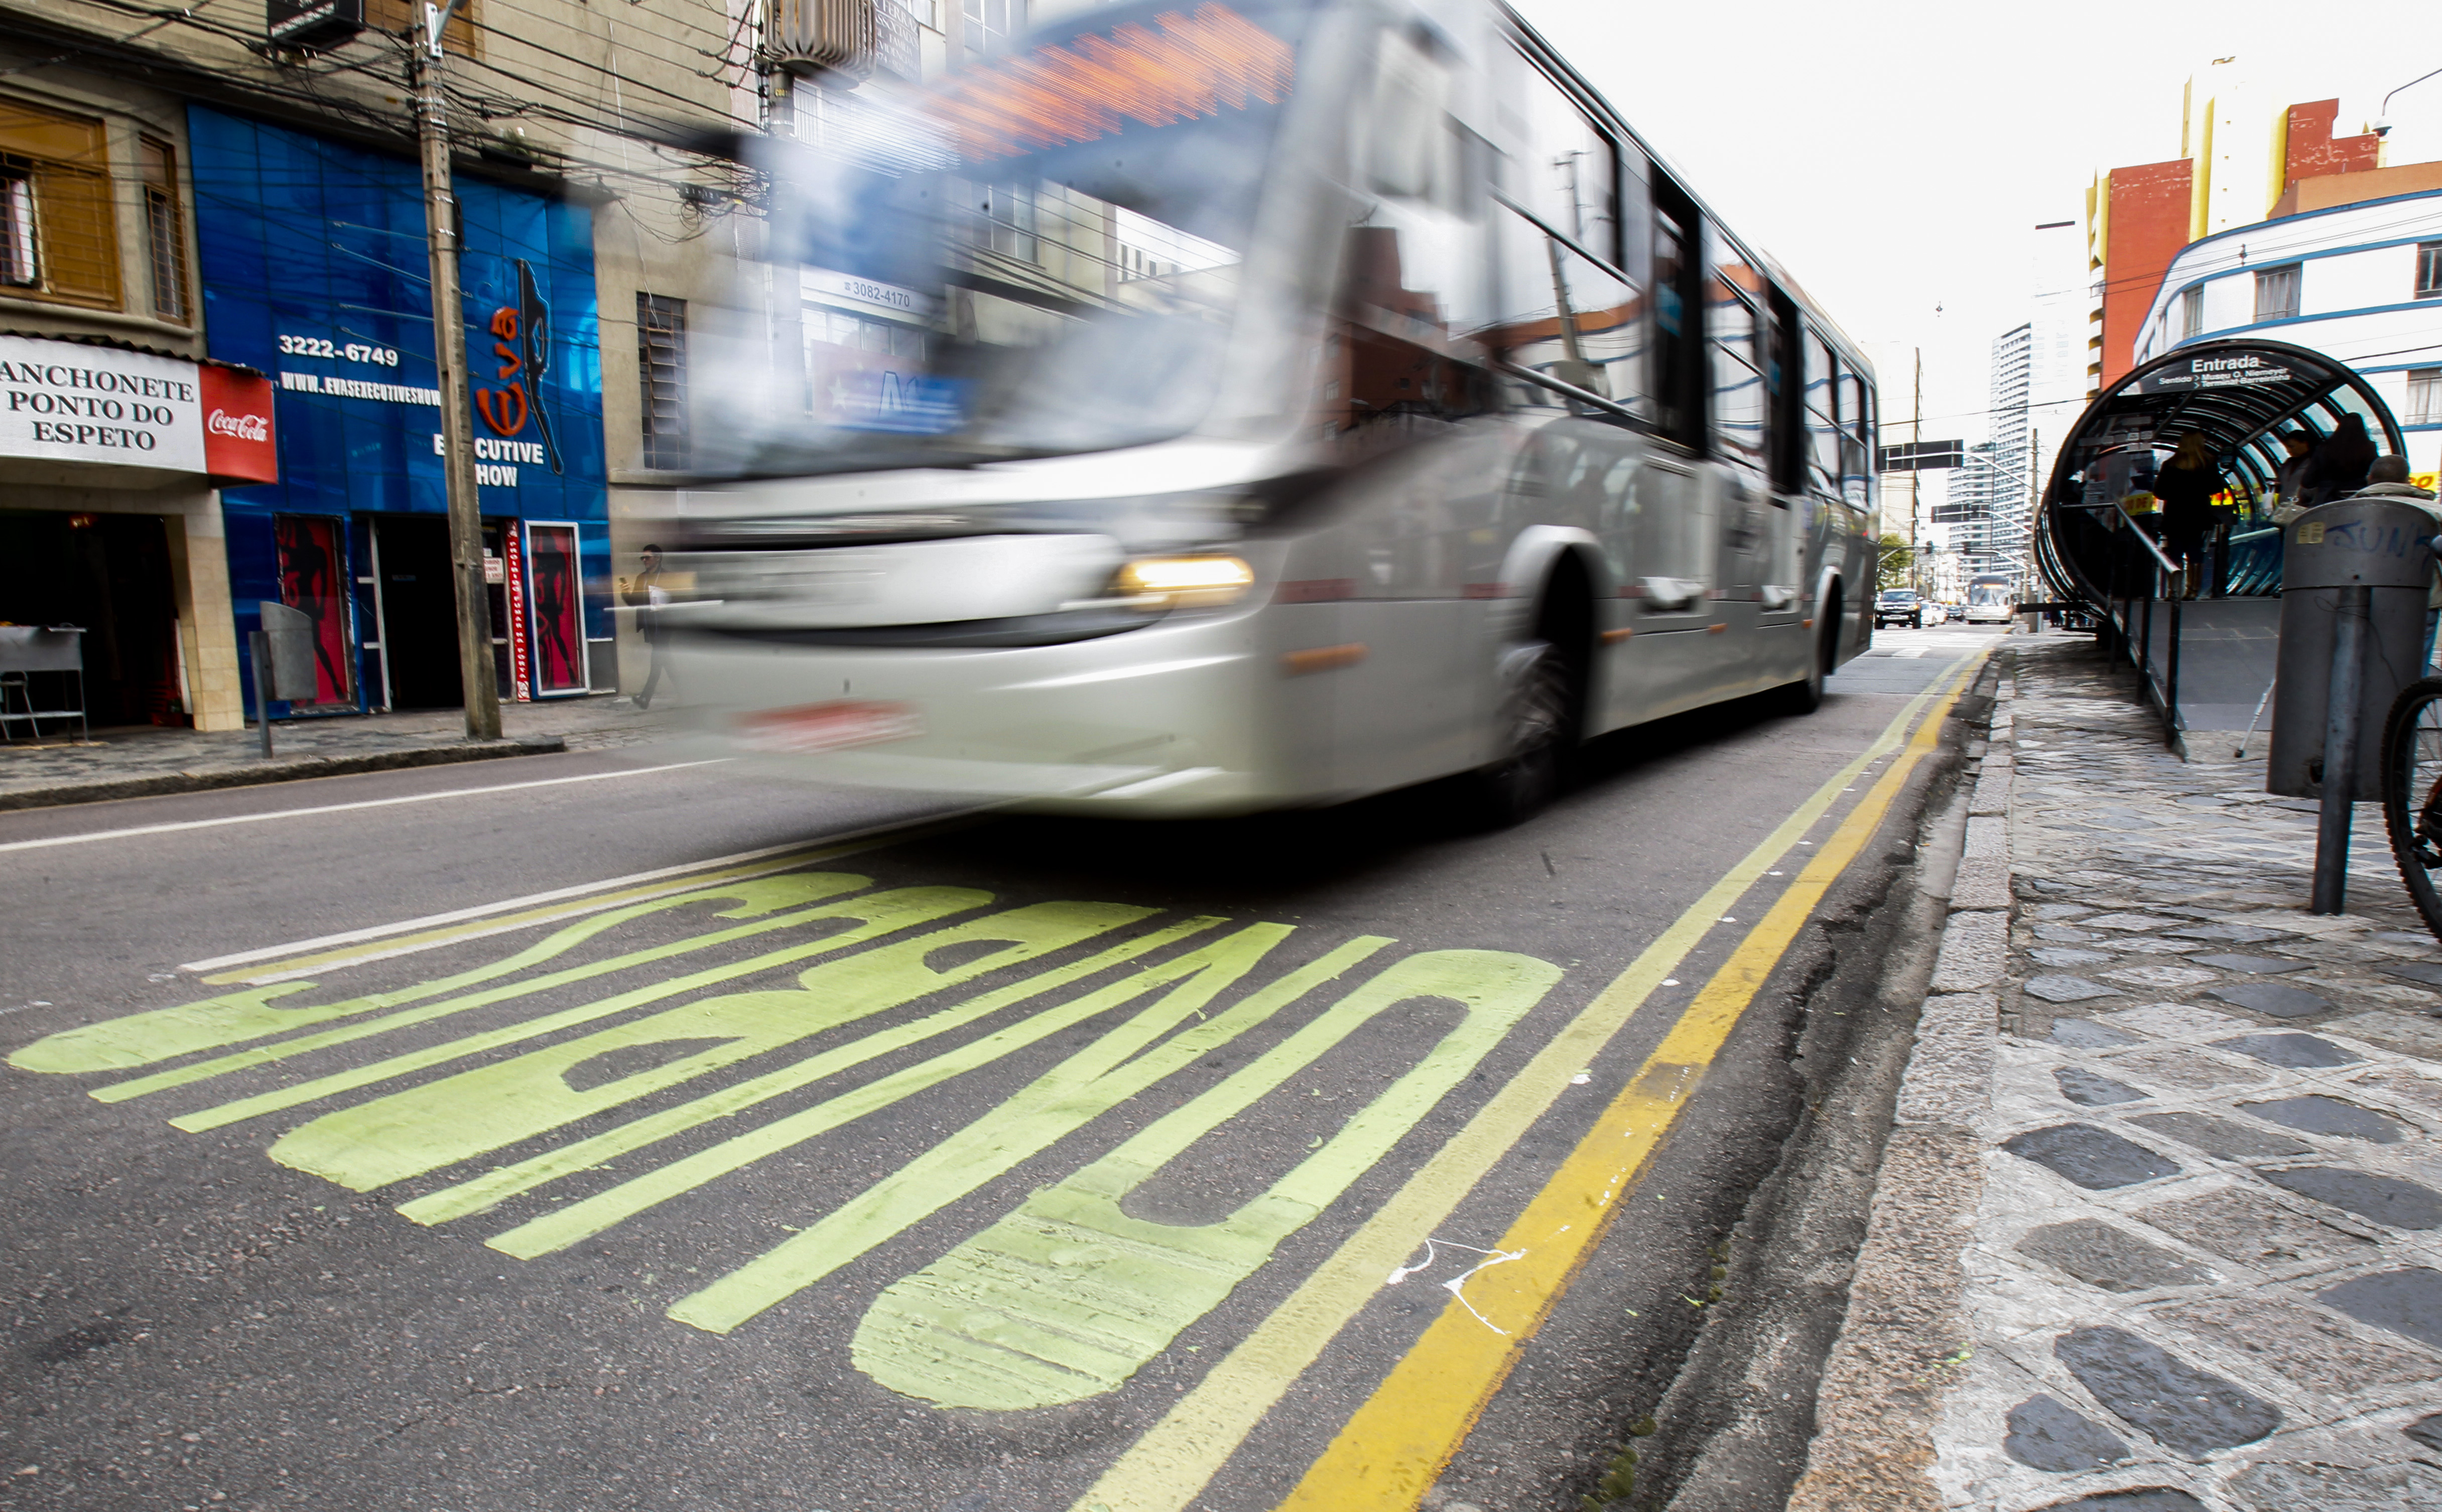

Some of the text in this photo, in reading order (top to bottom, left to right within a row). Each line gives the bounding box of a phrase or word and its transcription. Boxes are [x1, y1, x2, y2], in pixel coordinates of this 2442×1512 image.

[853, 282, 910, 307] 3082-4170
[279, 335, 399, 367] 3222-6749
[2192, 355, 2259, 373] Entrada
[0, 360, 194, 402] ANCHONETE
[2159, 376, 2192, 384] Sentido
[2202, 372, 2231, 380] Museu
[2245, 368, 2288, 377] Niemeyer
[2202, 379, 2238, 387] Terminal
[6, 389, 174, 426] PONTO DO
[30, 421, 157, 451] ESPETO
[433, 434, 544, 465] ECUTIVE
[475, 464, 518, 487] HOW
[509, 541, 520, 592] PROIBIDO
[513, 596, 523, 628] FUMAR
[517, 647, 527, 678] PORTA
[7, 872, 1565, 1411] ONIBUS
